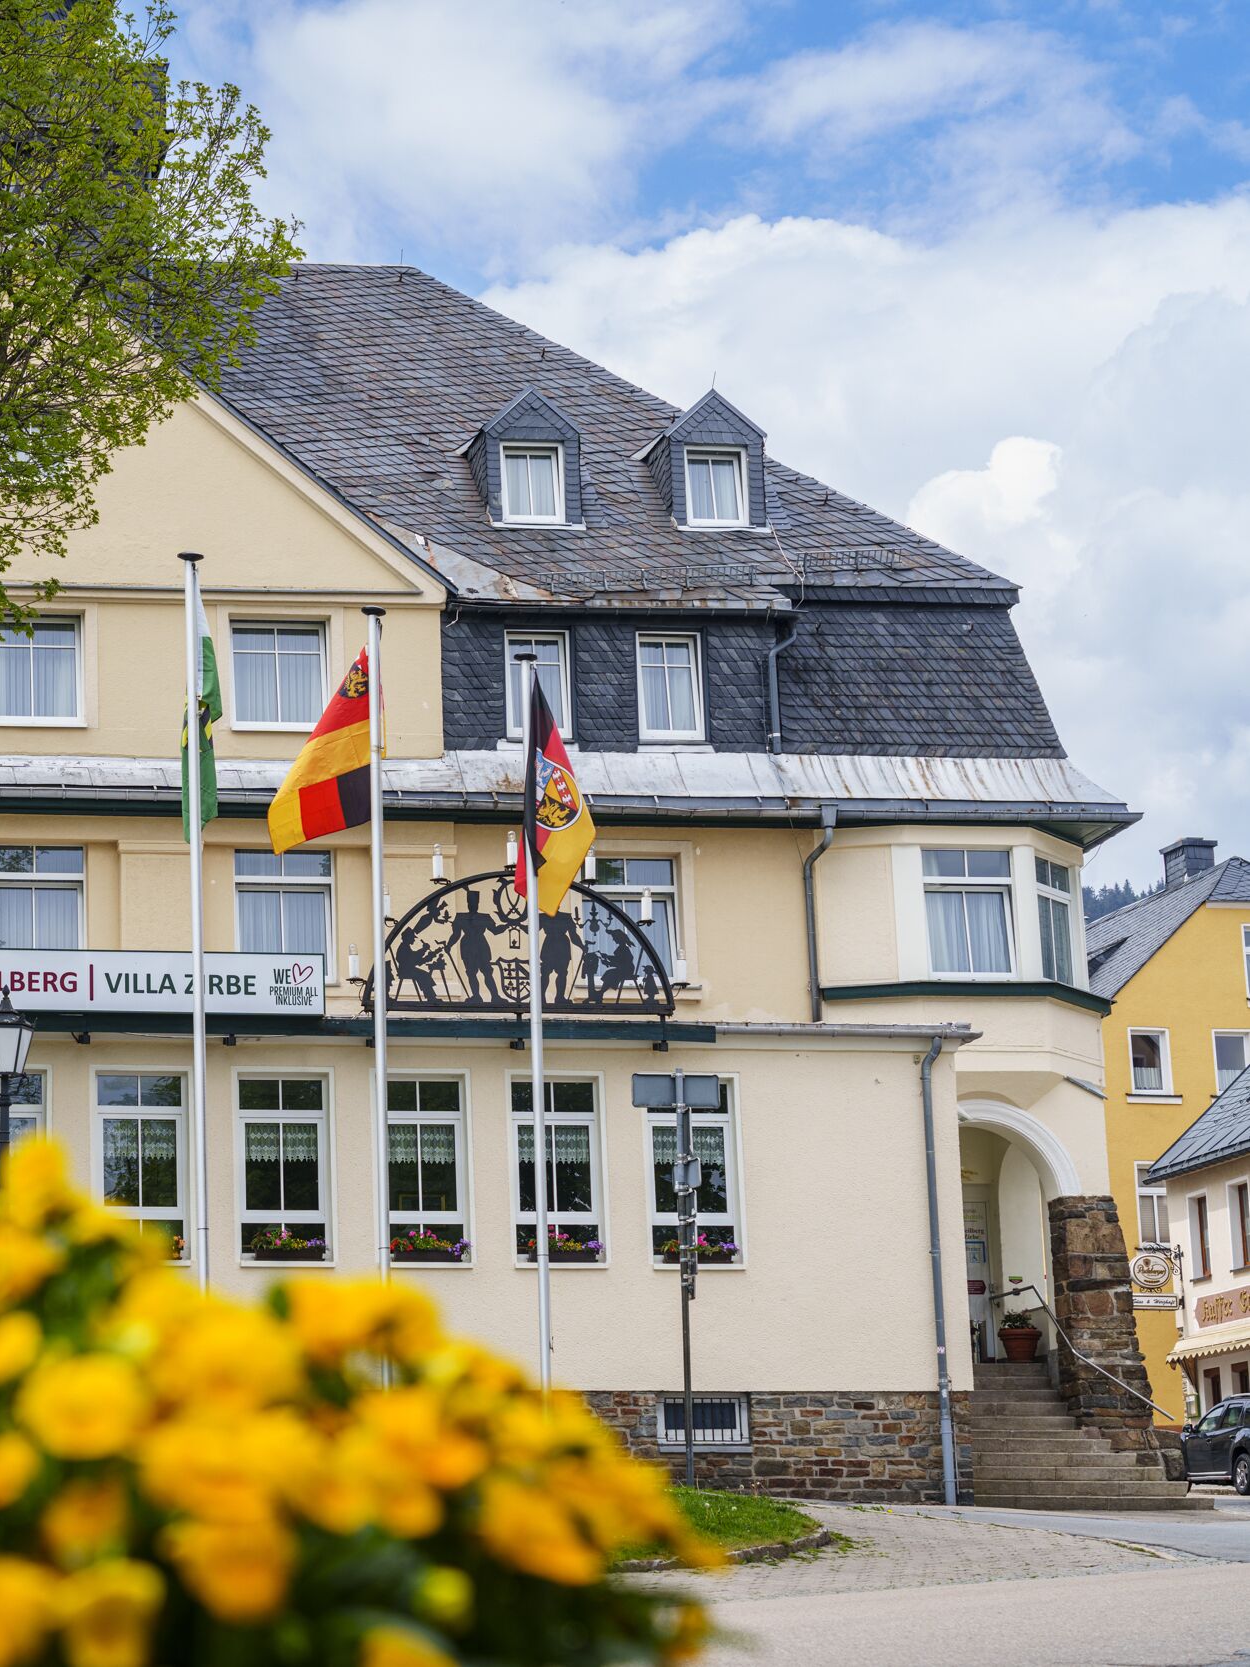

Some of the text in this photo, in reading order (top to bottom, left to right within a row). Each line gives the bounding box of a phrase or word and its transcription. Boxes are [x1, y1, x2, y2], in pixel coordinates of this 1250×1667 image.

[104, 972, 177, 994] VILLA
[273, 968, 292, 985] WE
[269, 986, 319, 997] PREMIUM ALL
[275, 996, 313, 1006] INKLUSIVE
